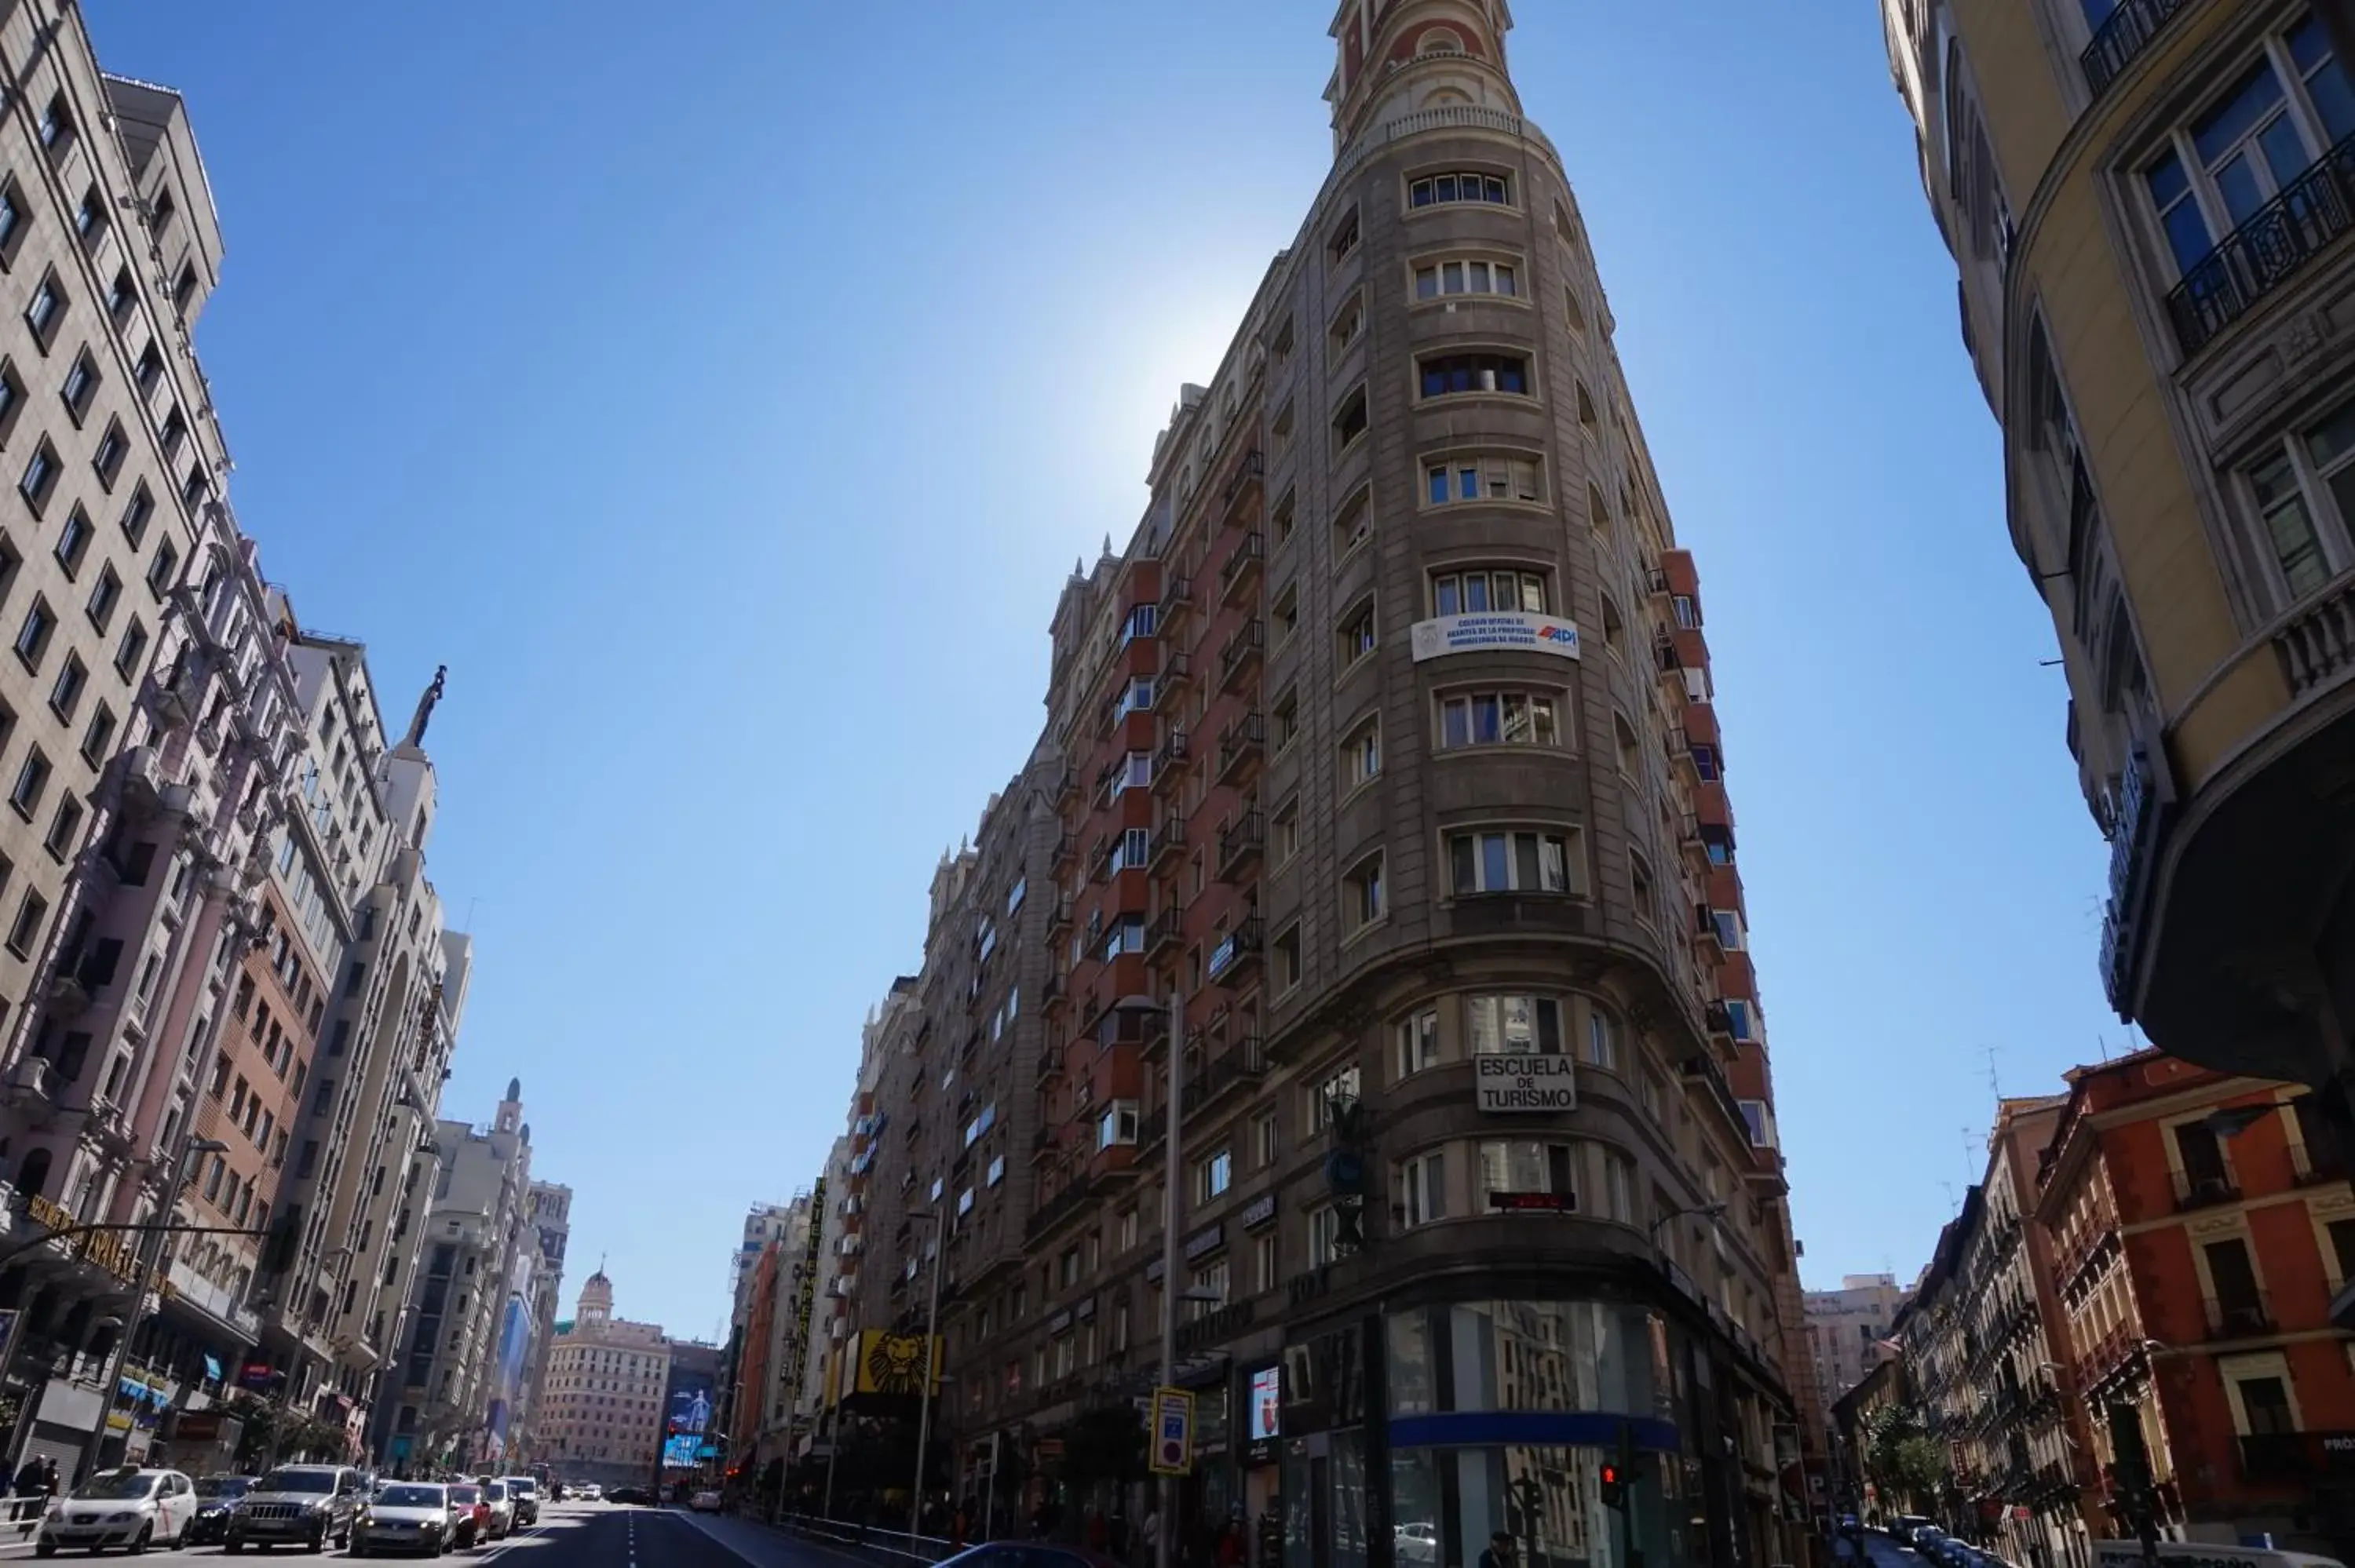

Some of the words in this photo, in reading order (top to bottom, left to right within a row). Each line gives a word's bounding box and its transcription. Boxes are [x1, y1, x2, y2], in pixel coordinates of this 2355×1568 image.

[1481, 1058, 1571, 1076] ESCUELA
[1517, 1078, 1534, 1088] DE
[1483, 1089, 1571, 1107] TURISMO
